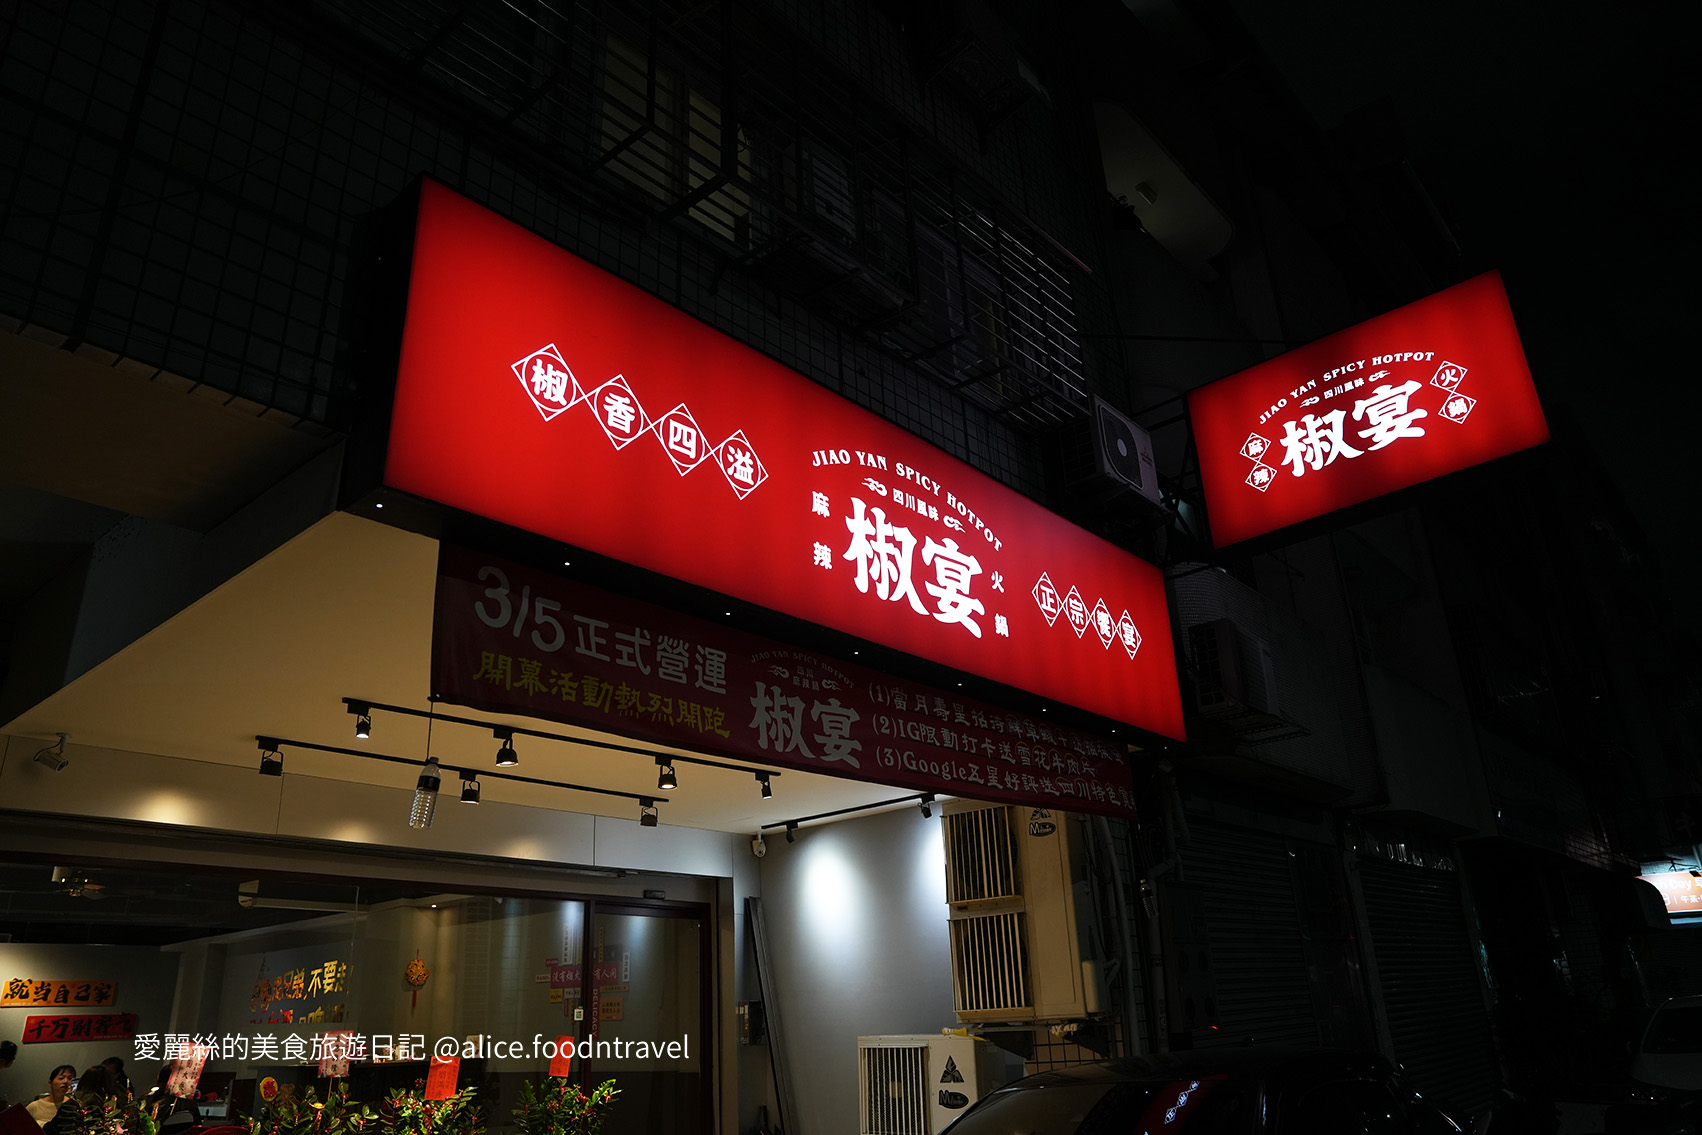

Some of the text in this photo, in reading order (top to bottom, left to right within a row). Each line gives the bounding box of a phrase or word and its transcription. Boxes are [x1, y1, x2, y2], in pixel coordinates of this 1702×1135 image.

[531, 358, 755, 486] 椒香四溢
[1259, 351, 1435, 424] JIAO YAN SPICY HOTPOT
[1279, 379, 1429, 478] 椒宴
[811, 490, 833, 570] 麻辣
[812, 449, 1002, 551] JIAO YAN SPICY HOTPOT
[893, 488, 939, 522] 四川風味
[842, 496, 986, 639] 椒宴
[472, 649, 732, 739] 開幕活動熱烈開跑
[751, 652, 770, 663] JIAO
[793, 652, 818, 666] SPICY
[748, 680, 864, 769] 椒宴
